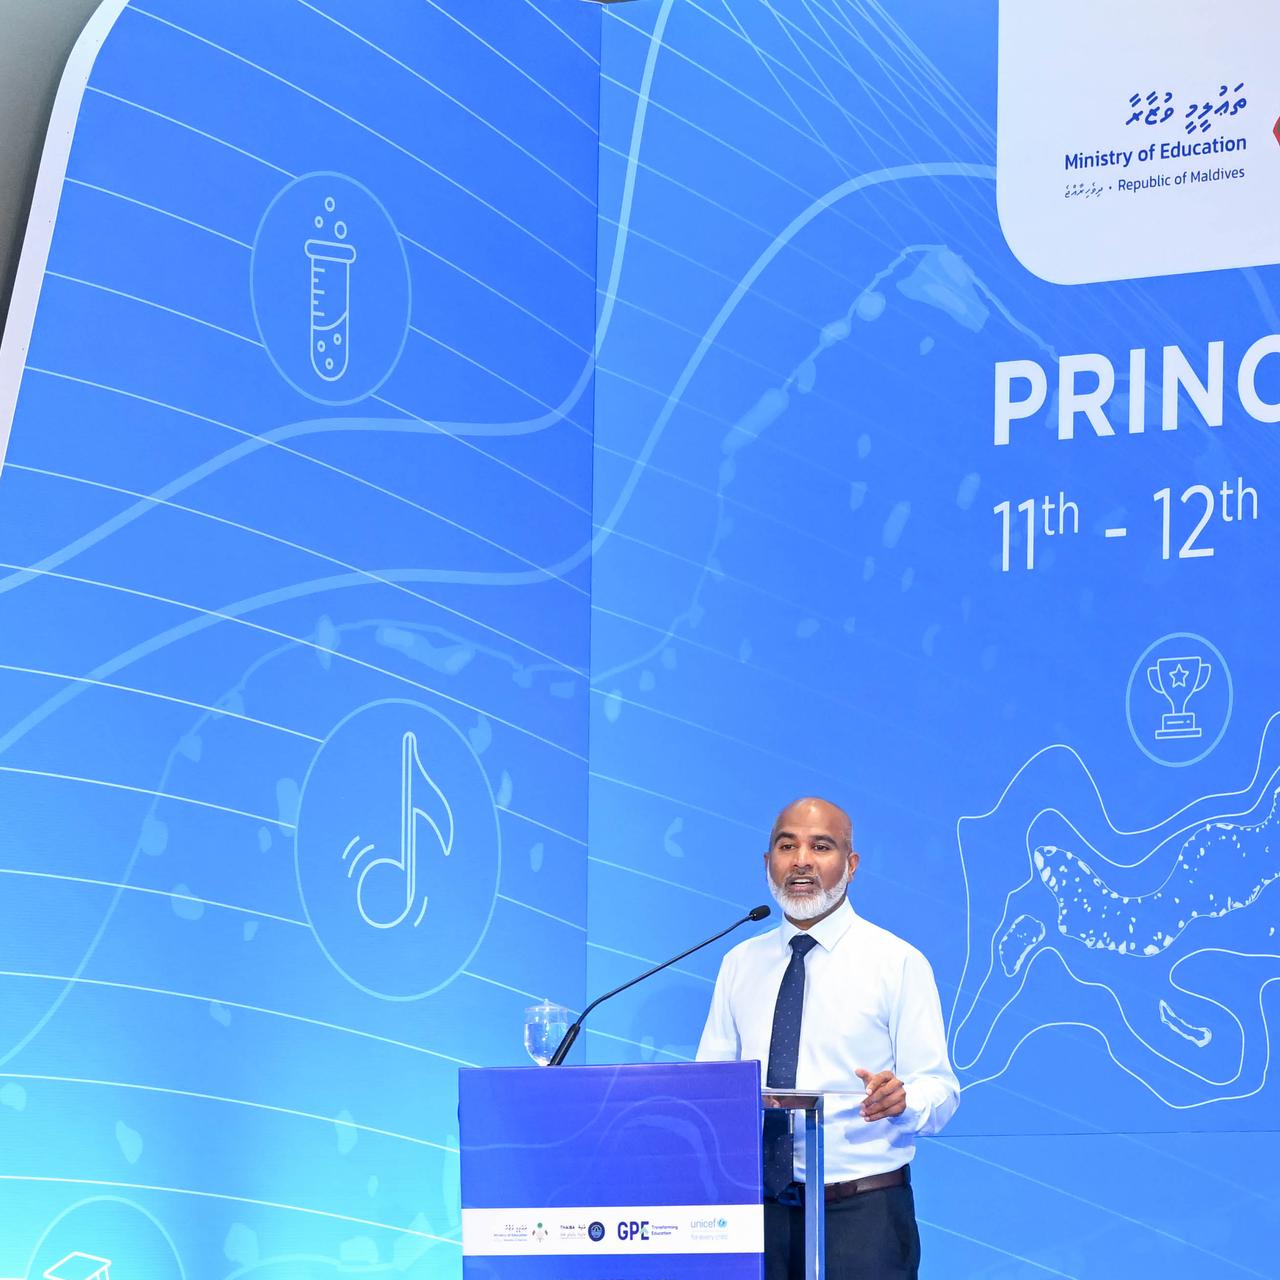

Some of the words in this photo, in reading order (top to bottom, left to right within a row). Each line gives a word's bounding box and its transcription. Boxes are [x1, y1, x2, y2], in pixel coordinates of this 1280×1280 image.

[1065, 150, 1133, 170] Ministry
[1138, 143, 1155, 162] of
[1160, 136, 1247, 160] Education
[1118, 174, 1171, 193] Republic
[1174, 171, 1187, 185] of
[1190, 167, 1245, 183] Maldives
[994, 491, 1080, 573] 11th
[1152, 476, 1259, 561] 12th
[617, 1220, 649, 1241] GPE
